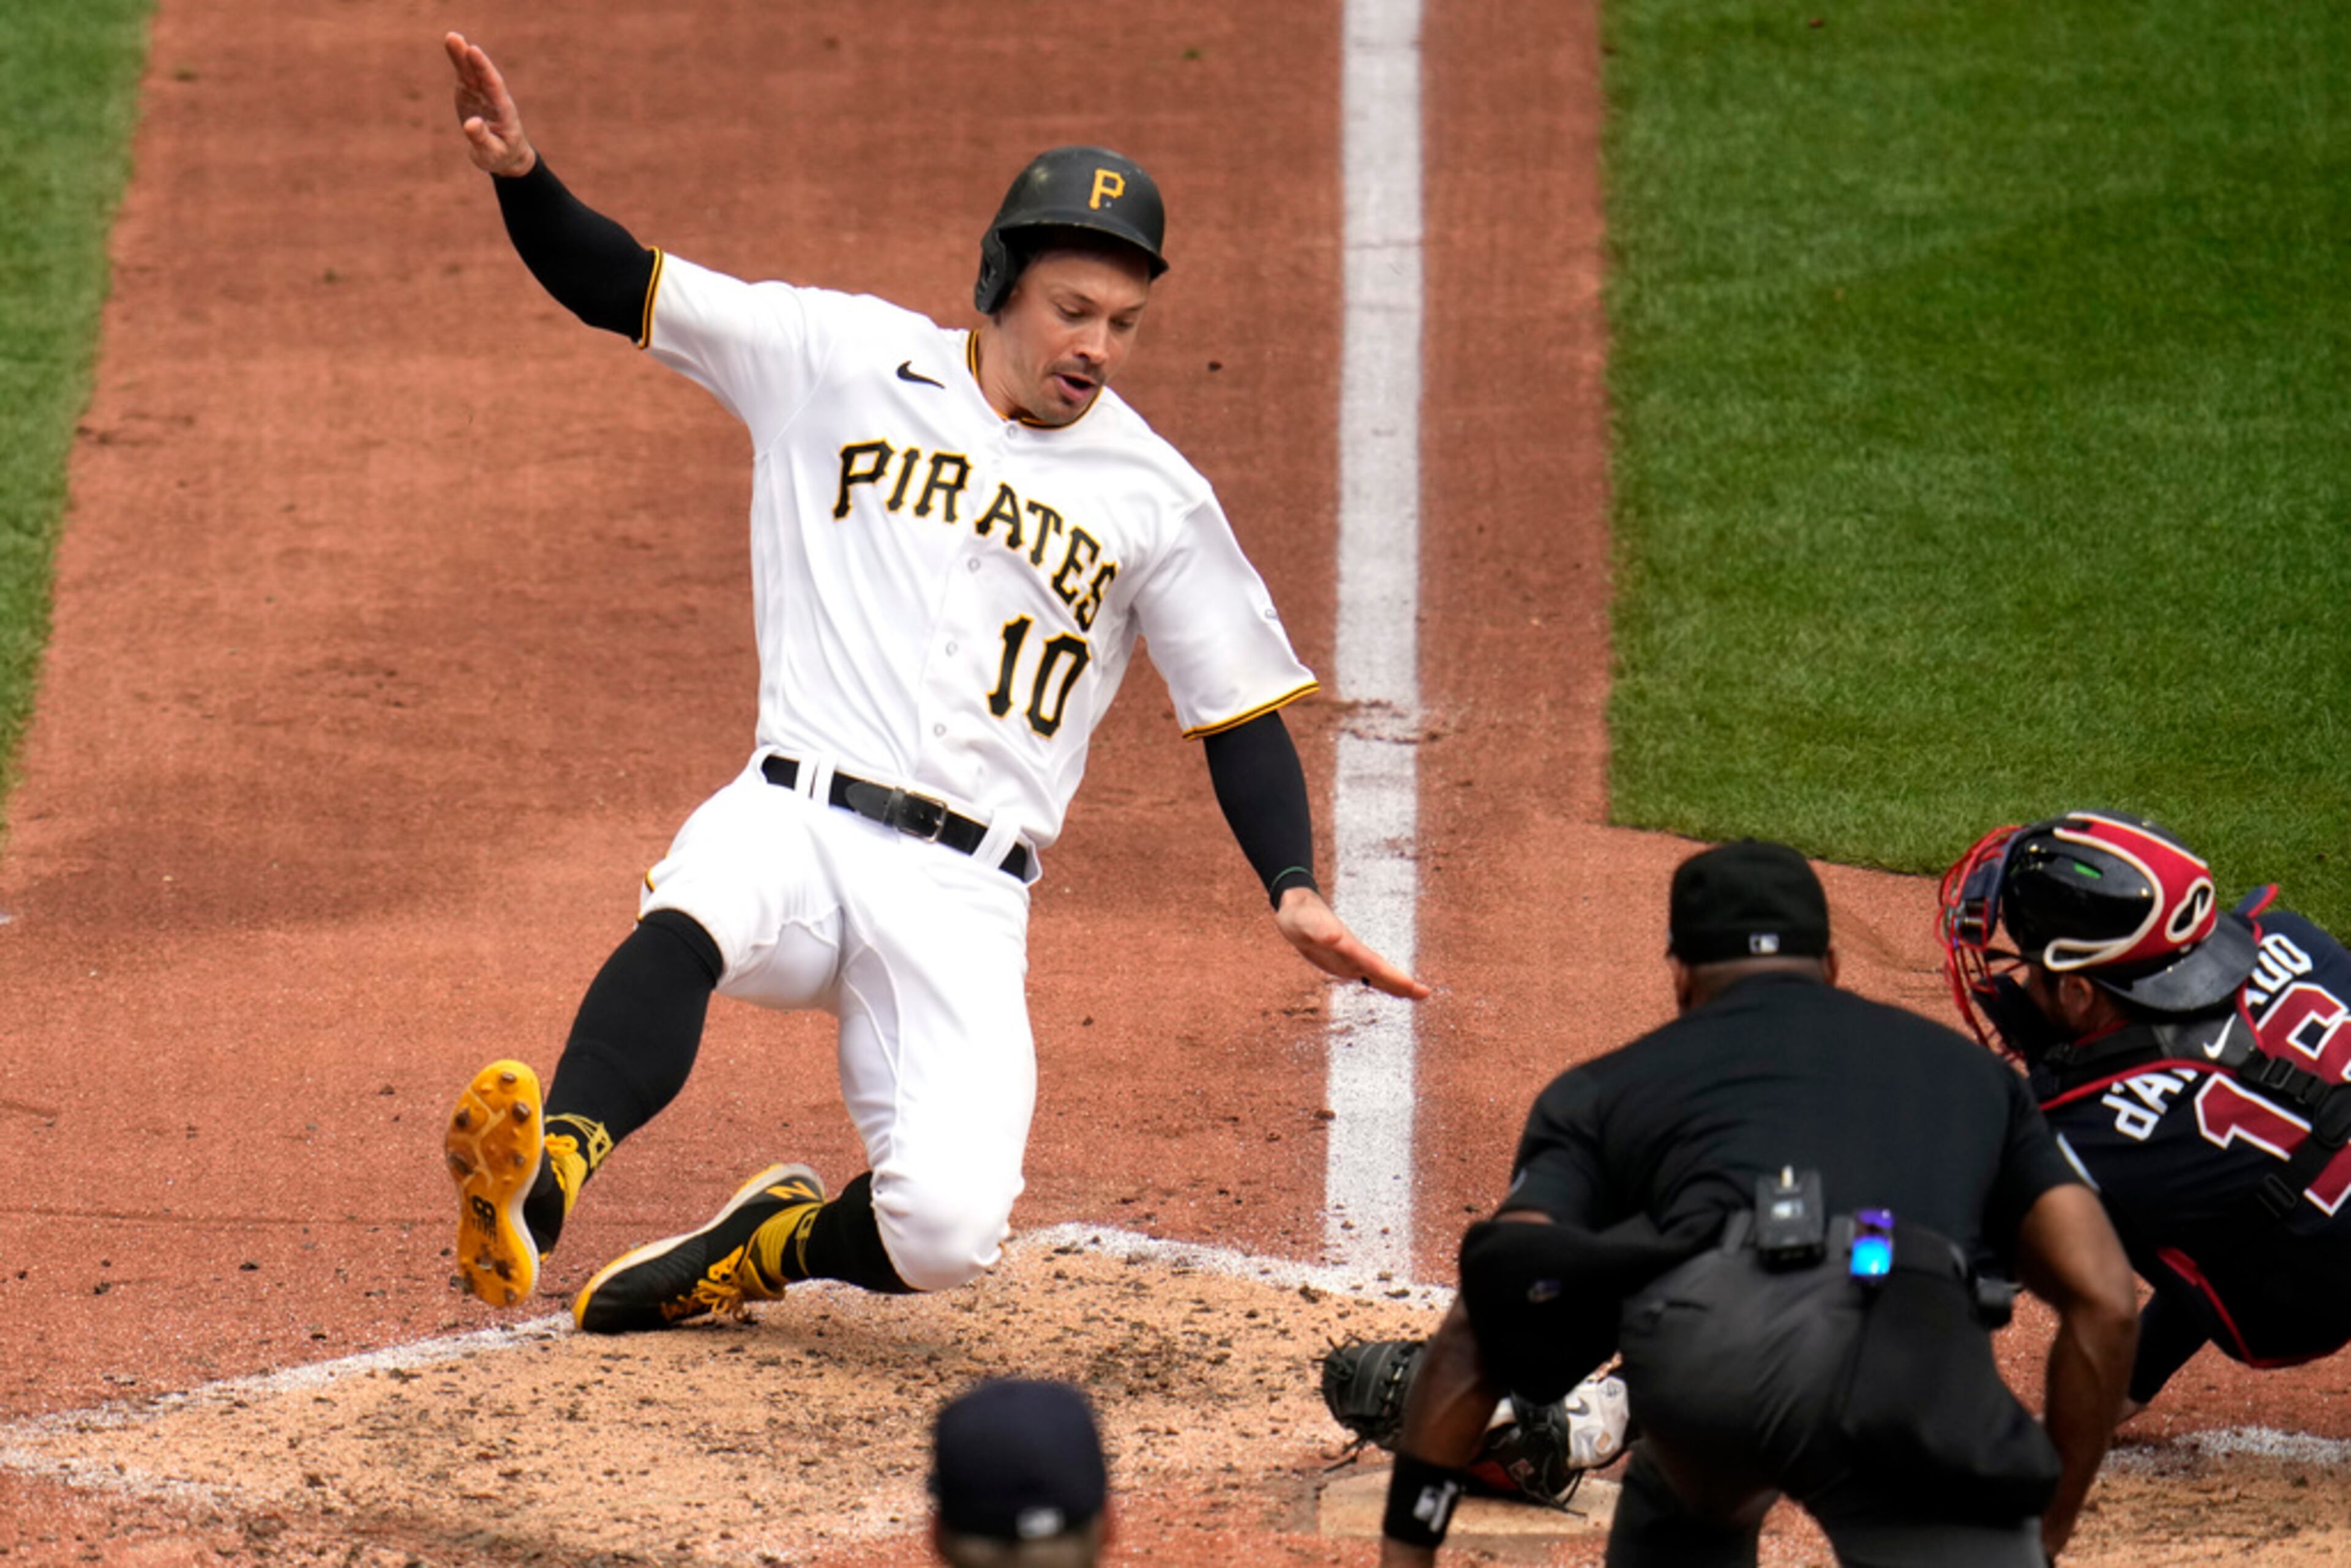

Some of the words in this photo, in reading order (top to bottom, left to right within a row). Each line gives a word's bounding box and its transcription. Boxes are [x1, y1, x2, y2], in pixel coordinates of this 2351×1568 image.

[1089, 168, 1126, 209] P
[833, 437, 1117, 632] PIRATES
[986, 614, 1091, 739] 10
